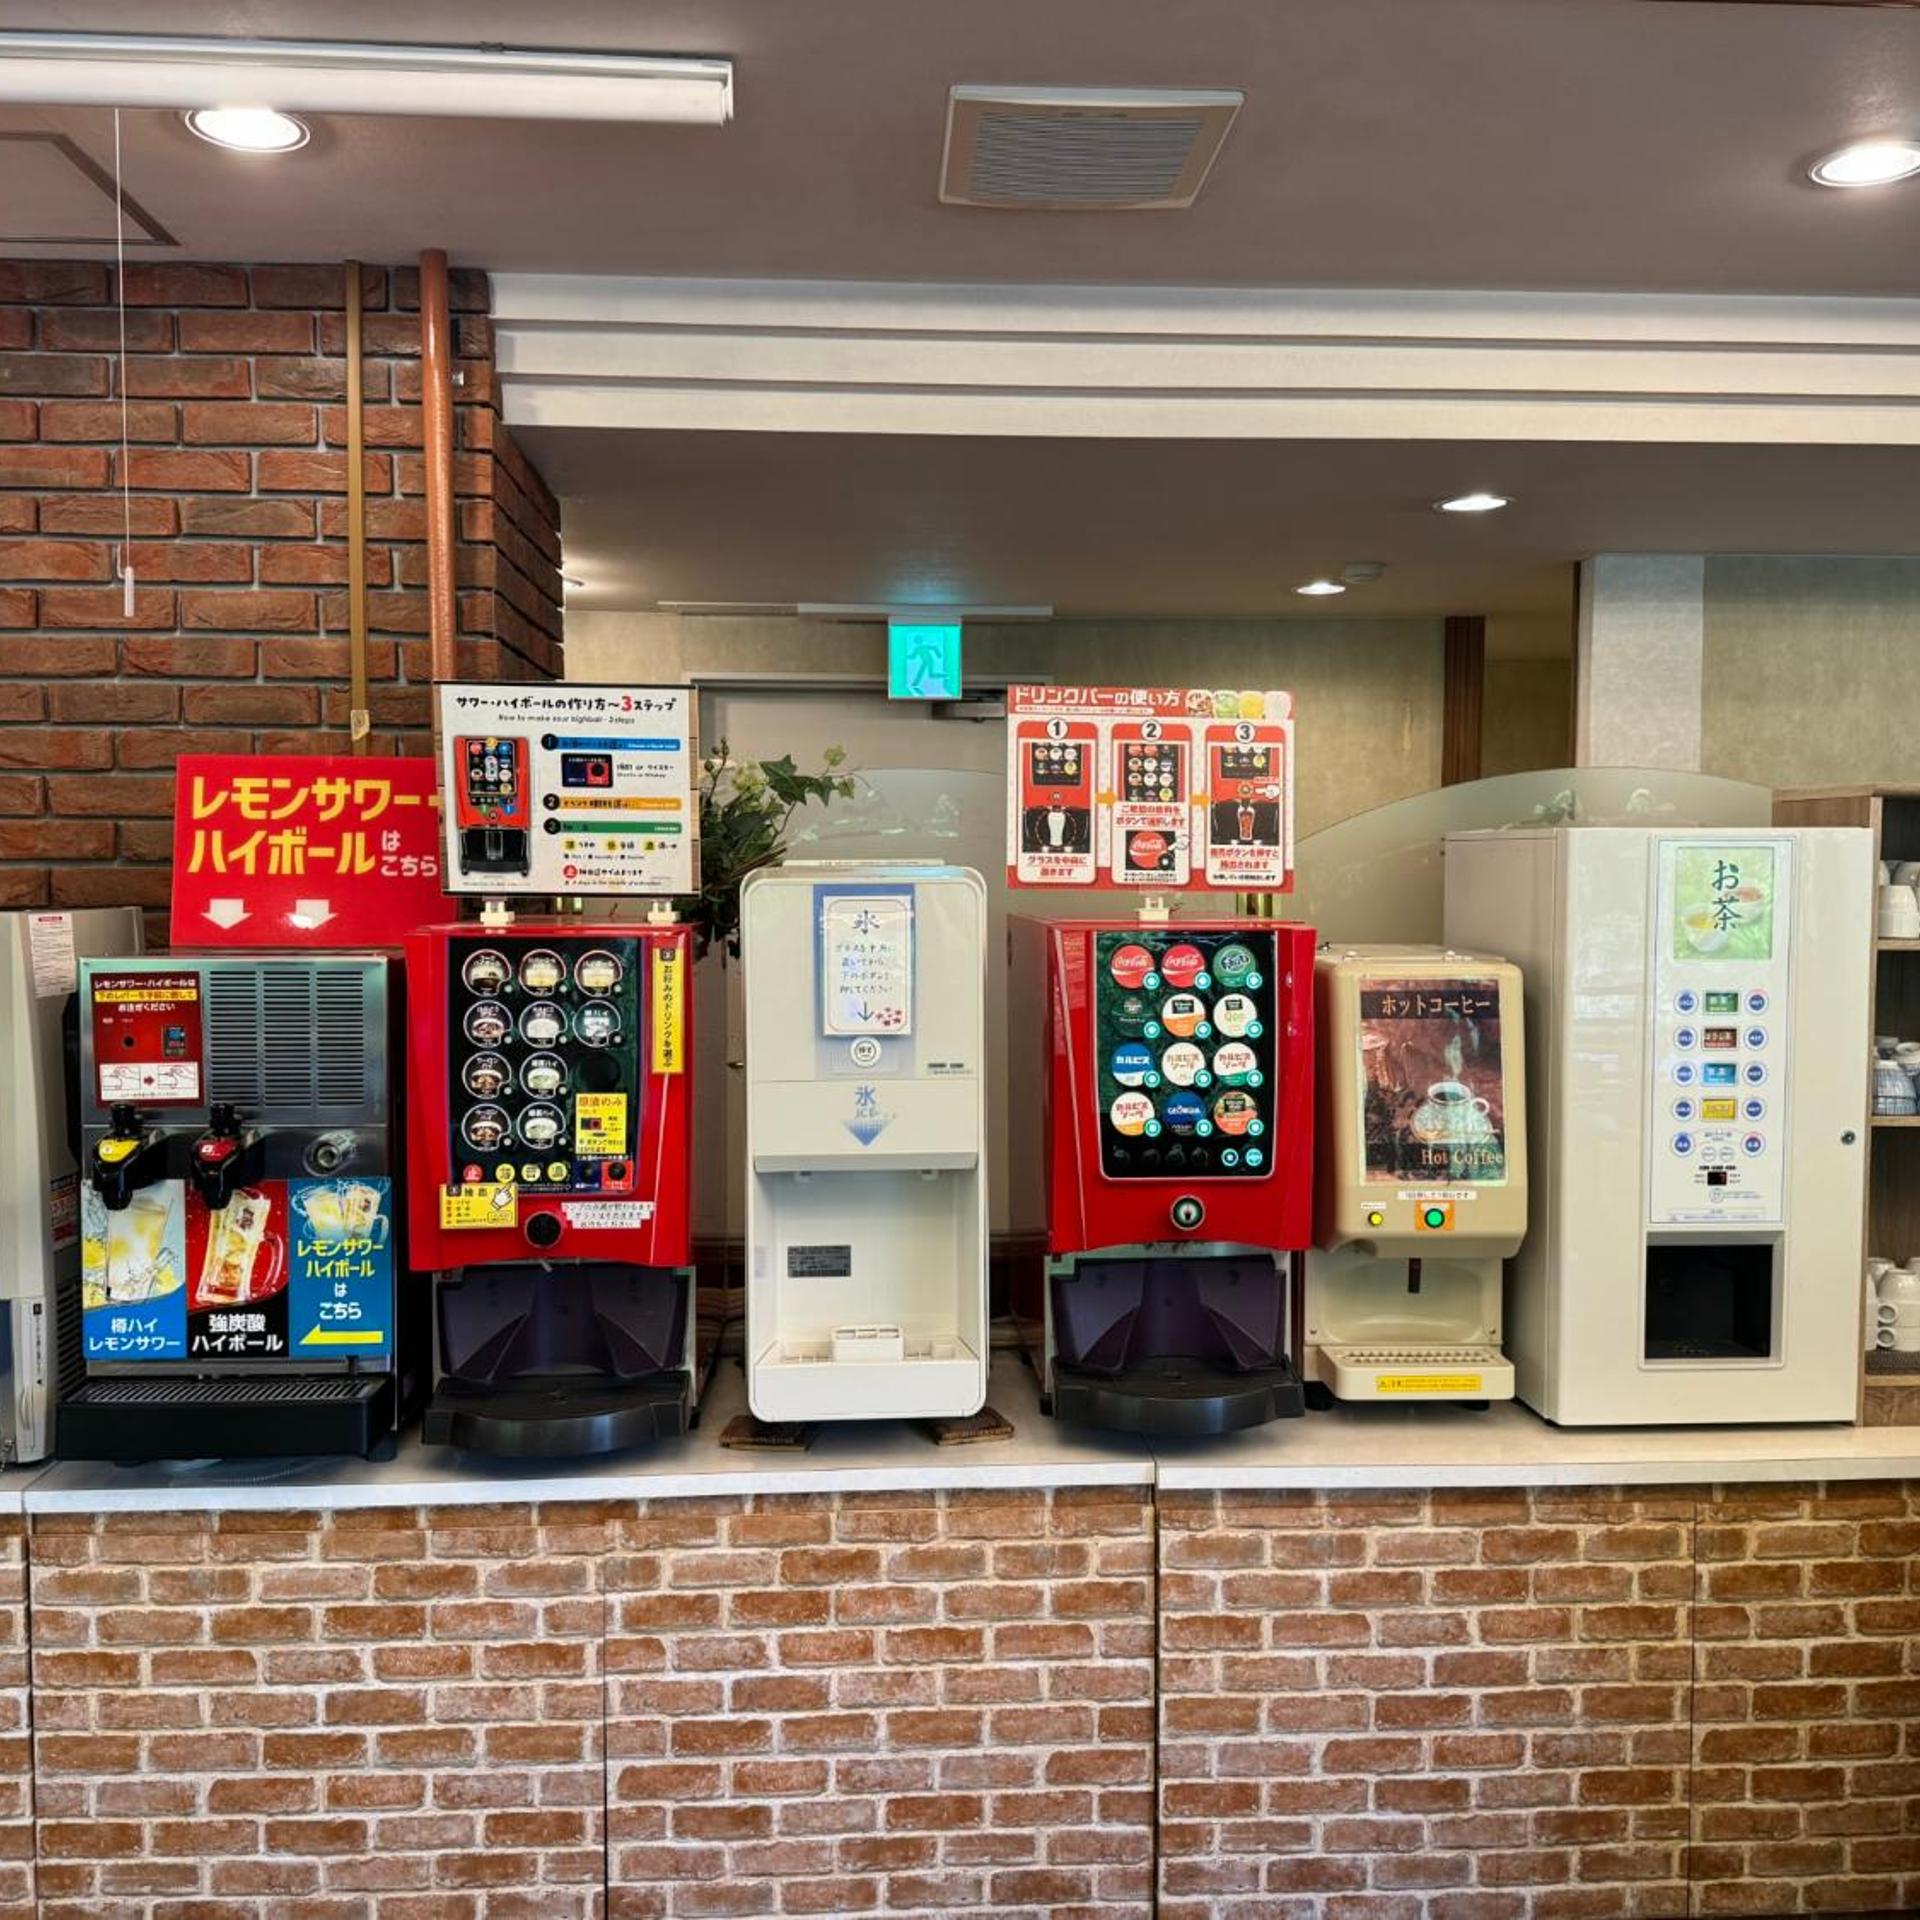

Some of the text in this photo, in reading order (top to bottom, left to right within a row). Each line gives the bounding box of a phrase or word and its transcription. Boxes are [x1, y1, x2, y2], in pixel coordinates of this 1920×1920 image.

[1015, 686, 1181, 706] ドリンクバーの使い方
[1053, 722, 1061, 736] 1
[1146, 724, 1157, 738] 2
[1240, 725, 1251, 740] 3
[381, 830, 401, 852] は
[187, 826, 376, 875] ハイボール
[380, 856, 438, 877] こちら
[1711, 859, 1742, 932] お茶
[853, 909, 880, 935] 氷
[1381, 994, 1491, 1016] ホットコーヒー
[855, 1085, 877, 1106] 氷
[1421, 1149, 1504, 1167] Hot Coffee
[298, 1239, 385, 1257] レモンサワー
[306, 1260, 375, 1278] ハイボール
[334, 1283, 347, 1298] は
[318, 1302, 363, 1320] こちら
[208, 1314, 267, 1332] 強炭酸
[89, 1337, 181, 1352] レモンサワー
[192, 1334, 283, 1352] ハイボール
